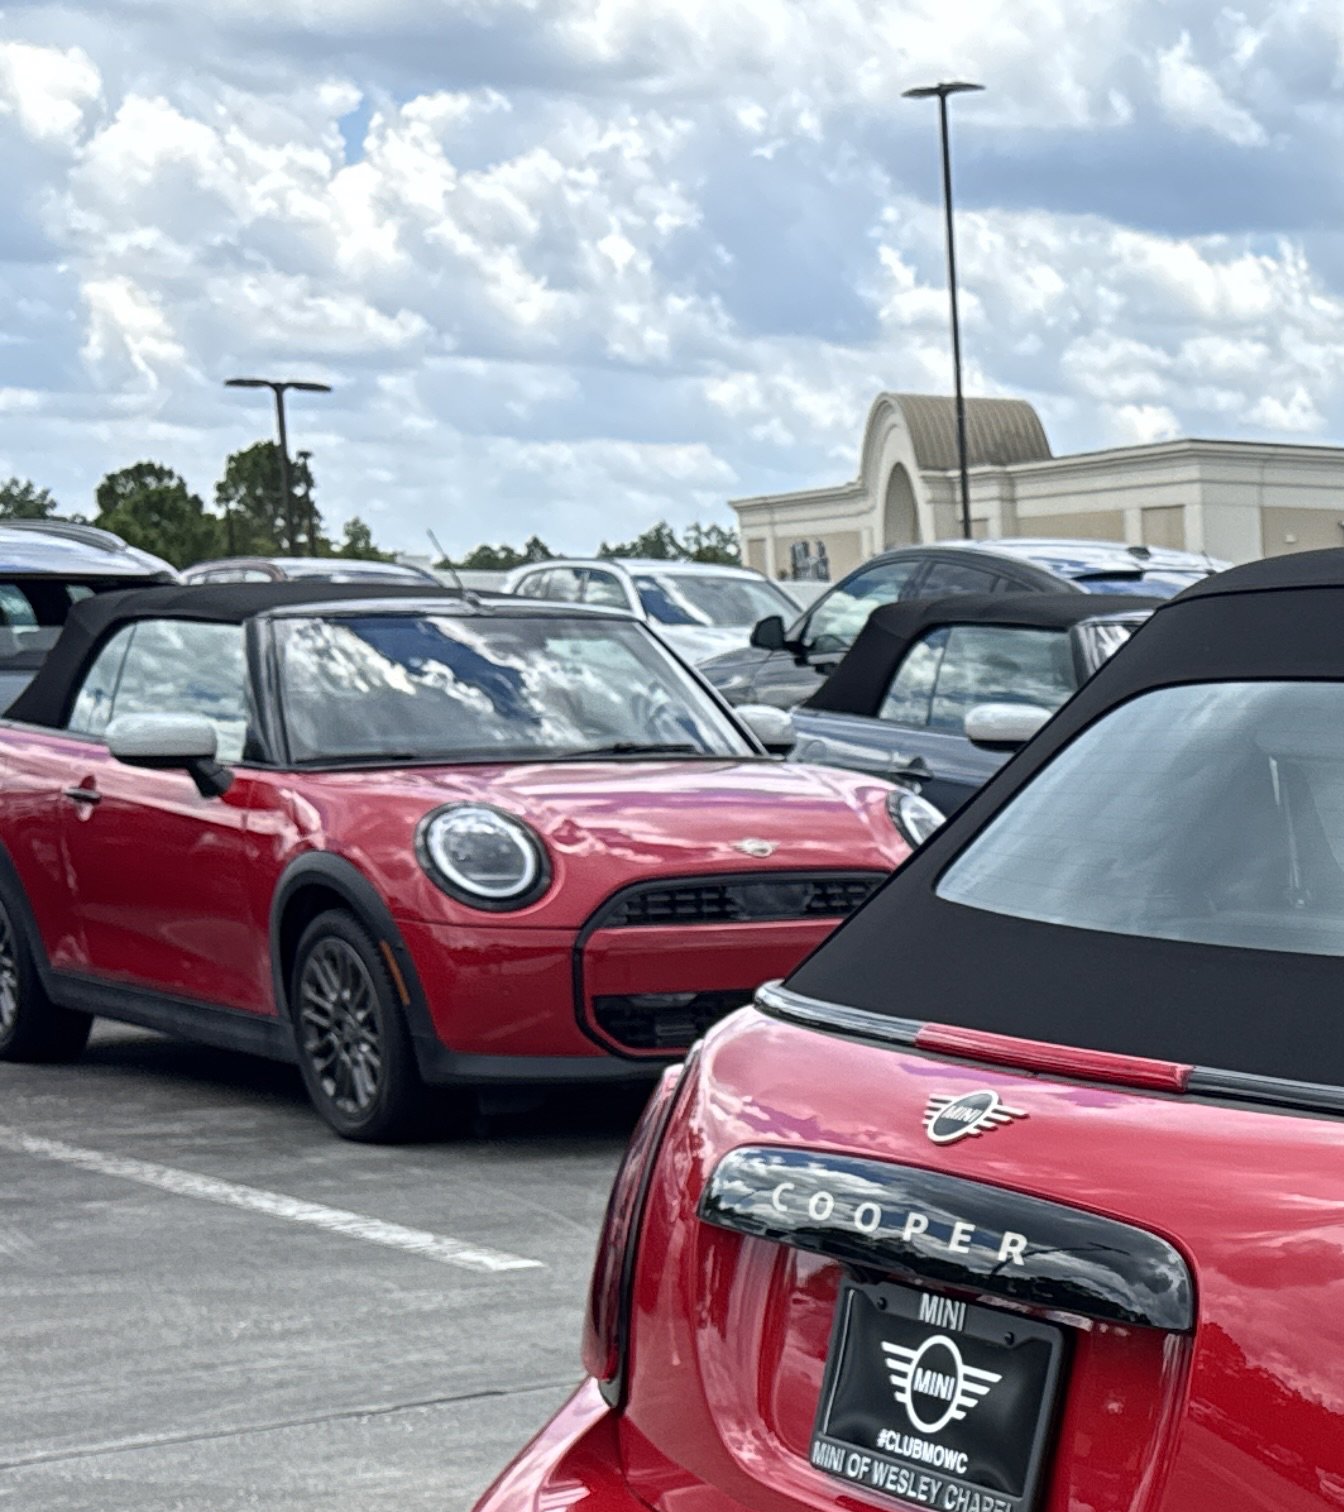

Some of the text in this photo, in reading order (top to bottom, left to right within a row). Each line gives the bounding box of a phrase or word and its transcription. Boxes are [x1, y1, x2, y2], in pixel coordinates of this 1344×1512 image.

[942, 1105, 981, 1124] MINI
[771, 1181, 1029, 1266] COOPER
[919, 1293, 966, 1331] MINI
[913, 1366, 955, 1401] MINI
[811, 1440, 845, 1472] MINI
[847, 1453, 871, 1479] OF
[872, 1460, 942, 1504] WESLEY
[876, 1428, 969, 1475] #CLUBMOWC
